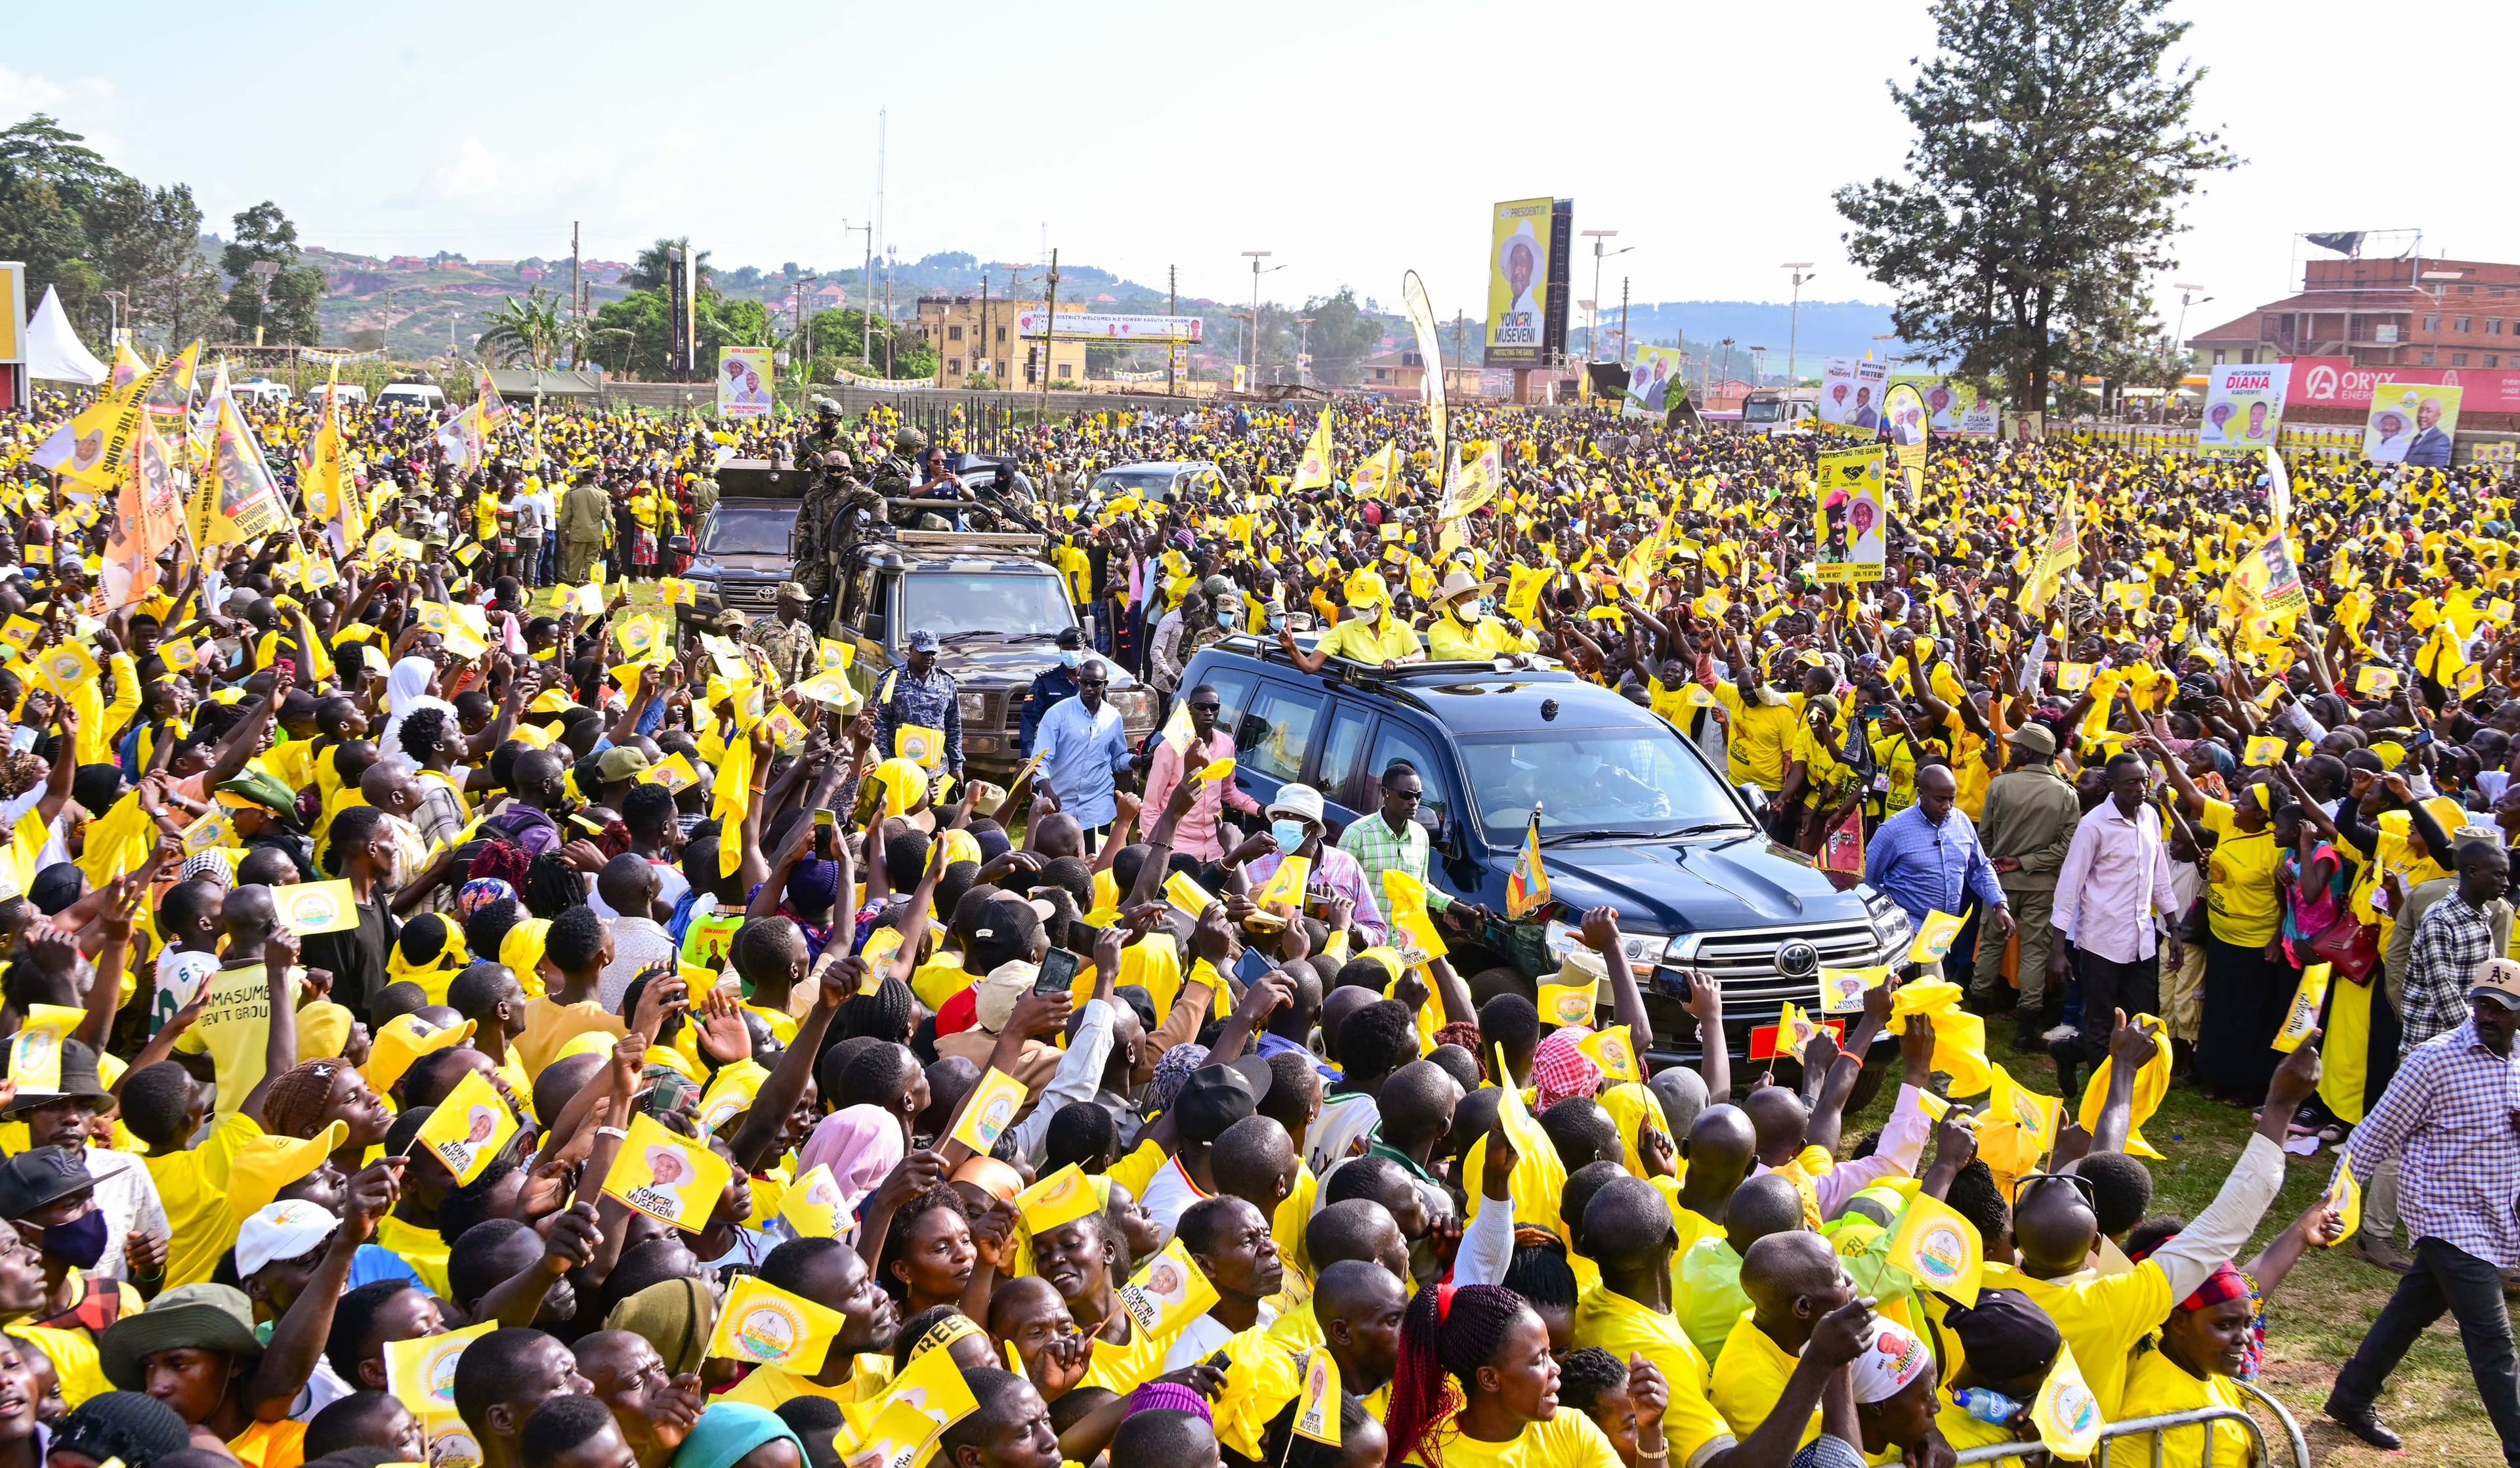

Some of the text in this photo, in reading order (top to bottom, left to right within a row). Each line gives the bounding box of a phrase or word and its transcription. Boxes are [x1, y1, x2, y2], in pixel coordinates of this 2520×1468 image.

[1511, 205, 1540, 217] PRESIDENT
[1500, 311, 1532, 327] YOWERI
[1494, 327, 1536, 343] MUSEVENI
[2226, 377, 2270, 388] DIANA
[115, 411, 132, 434] THE
[102, 435, 126, 474] GAINS
[1818, 449, 1853, 459] PROTECTING
[1865, 446, 1881, 455] GAINS
[1404, 955, 1427, 965] SEVENI
[2485, 966, 2511, 984] A's
[236, 1005, 268, 1020] GROU
[315, 1065, 331, 1076] K
[668, 1135, 699, 1150] PRESIDENT
[625, 1190, 675, 1219] MUSEVENI
[637, 1185, 674, 1209] YOWERI
[1180, 1253, 1200, 1280] PRESIDENT
[1120, 1286, 1152, 1328] MUSEVENI
[1127, 1283, 1155, 1318] YOWERI
